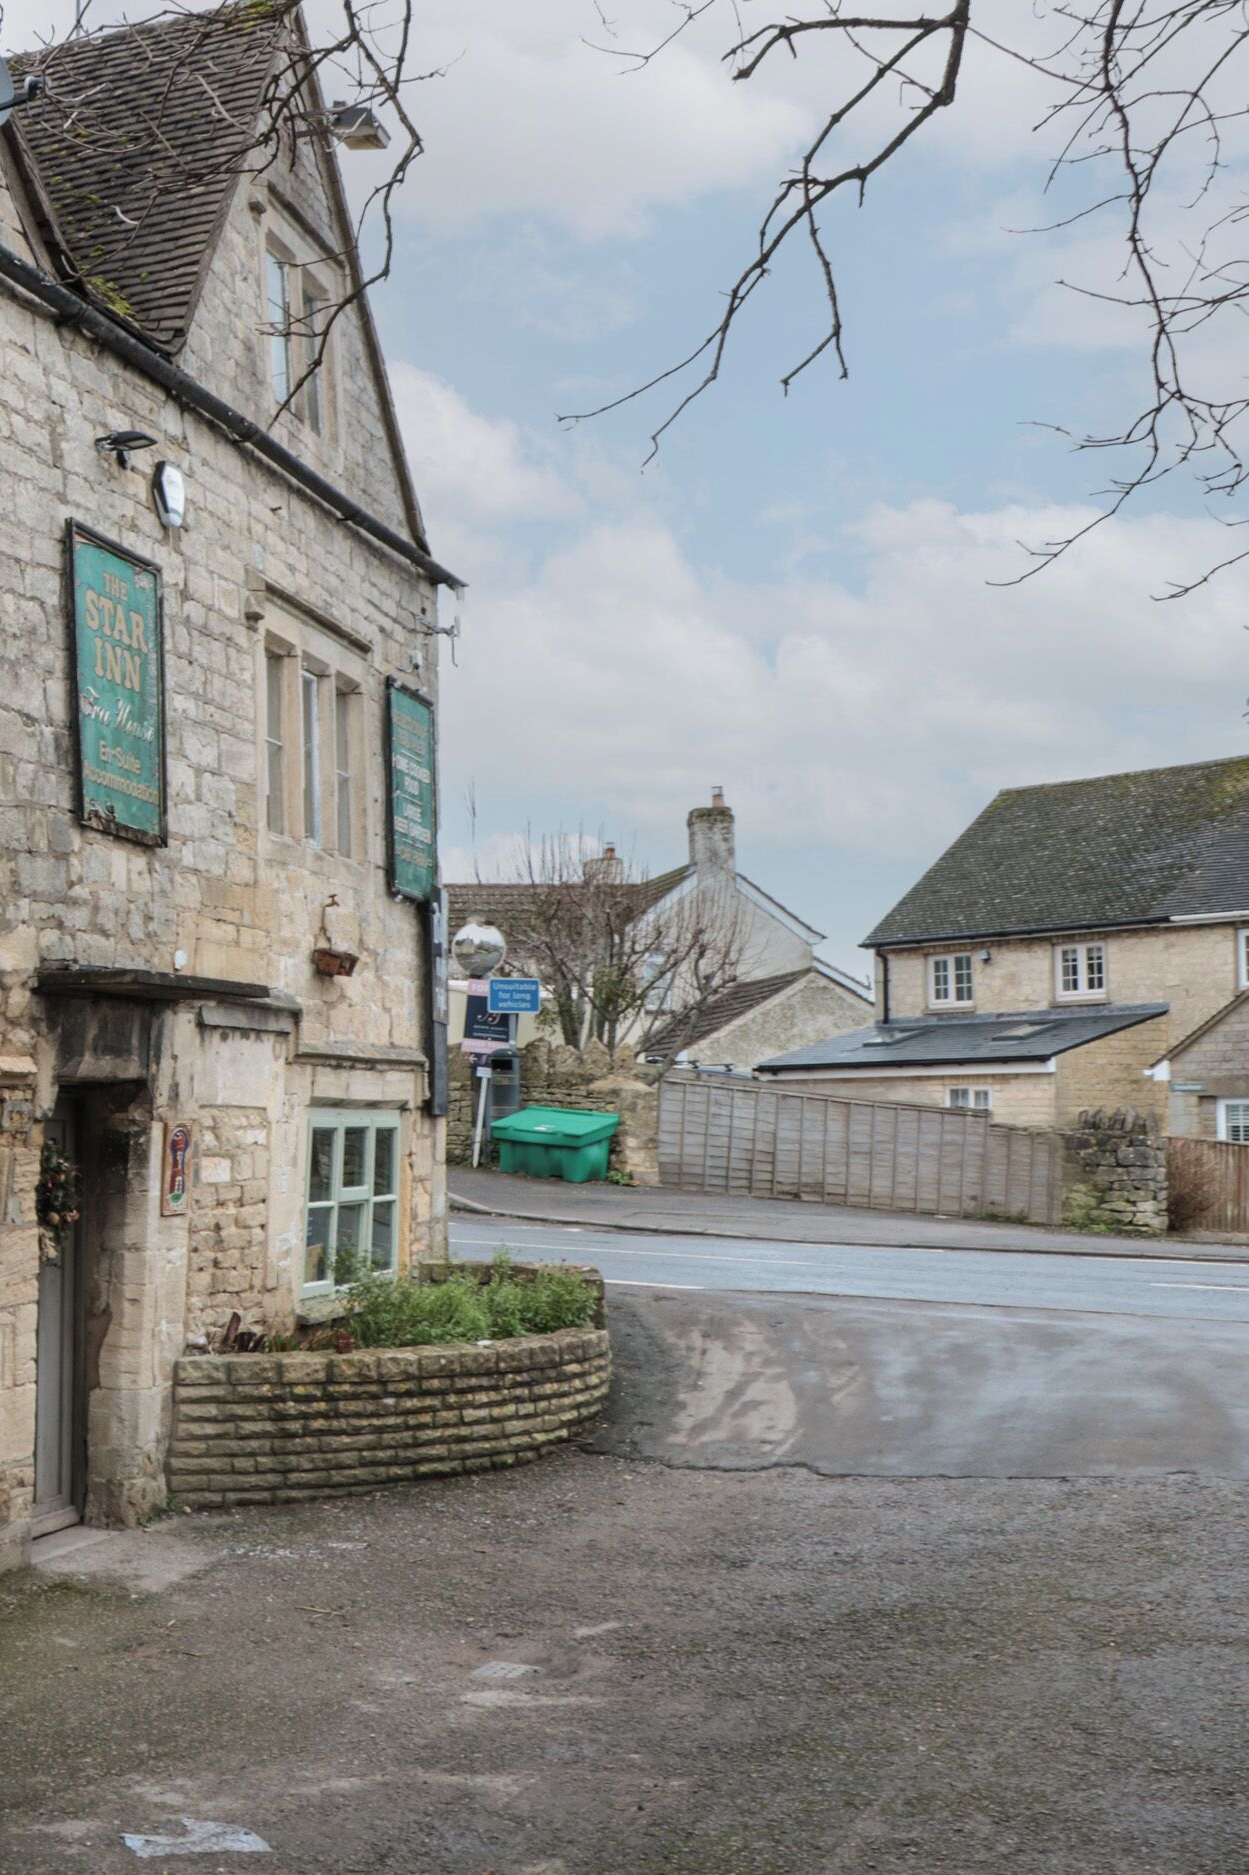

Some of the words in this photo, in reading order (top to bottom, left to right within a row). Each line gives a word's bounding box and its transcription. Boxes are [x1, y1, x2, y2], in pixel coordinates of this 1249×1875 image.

[103, 571, 128, 601] THE
[85, 588, 148, 654] STAR
[94, 637, 141, 692] INN
[114, 697, 155, 743] House
[99, 740, 141, 775] En-Suite
[492, 982, 537, 991] Unsuitable
[498, 991, 510, 999] for
[512, 992, 531, 1001] long
[498, 1001, 531, 1009] vehicles
